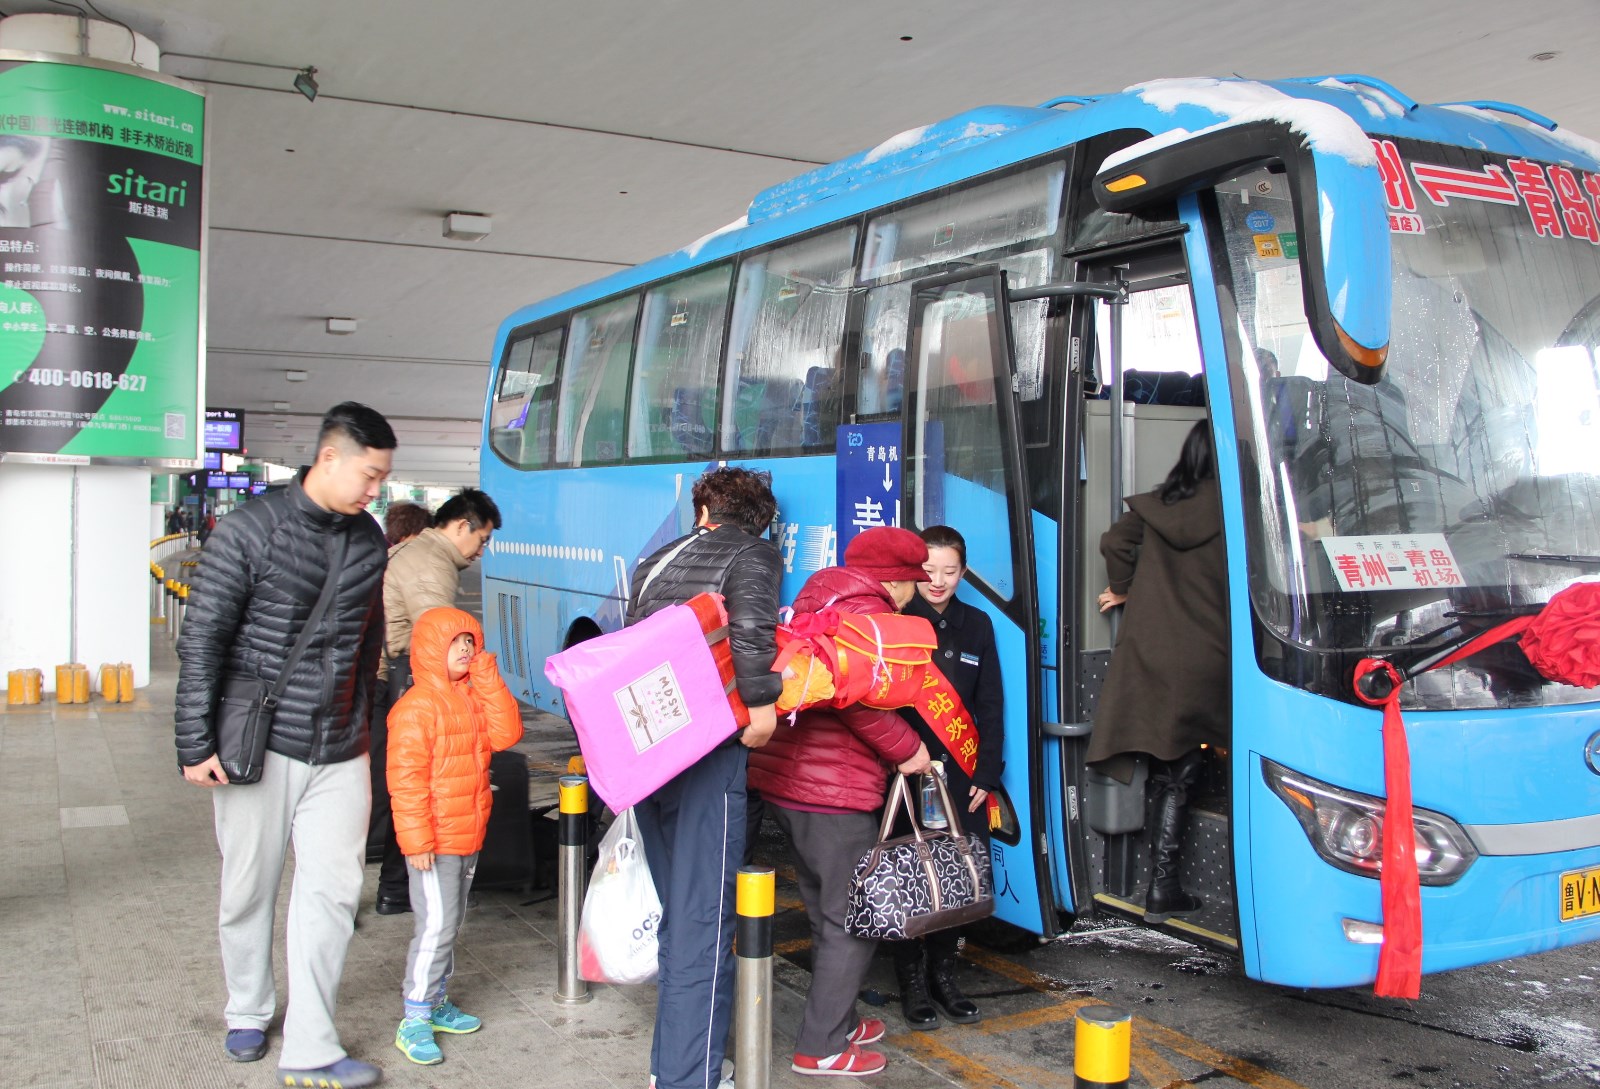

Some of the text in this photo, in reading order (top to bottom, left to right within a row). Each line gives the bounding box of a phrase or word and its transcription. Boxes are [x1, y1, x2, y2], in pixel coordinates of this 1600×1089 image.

[103, 104, 194, 134] www.sitari.cn
[120, 127, 194, 159] 非手术矫治近视
[107, 168, 187, 207] sitari
[128, 201, 169, 220] 斯塔瑞
[1253, 220, 1269, 228] 2017
[1261, 249, 1279, 257] 2017
[29, 368, 147, 391] 400-0618-627
[1404, 549, 1451, 568] 青岛
[1413, 568, 1461, 587] 机场
[659, 676, 682, 717] MDSW
